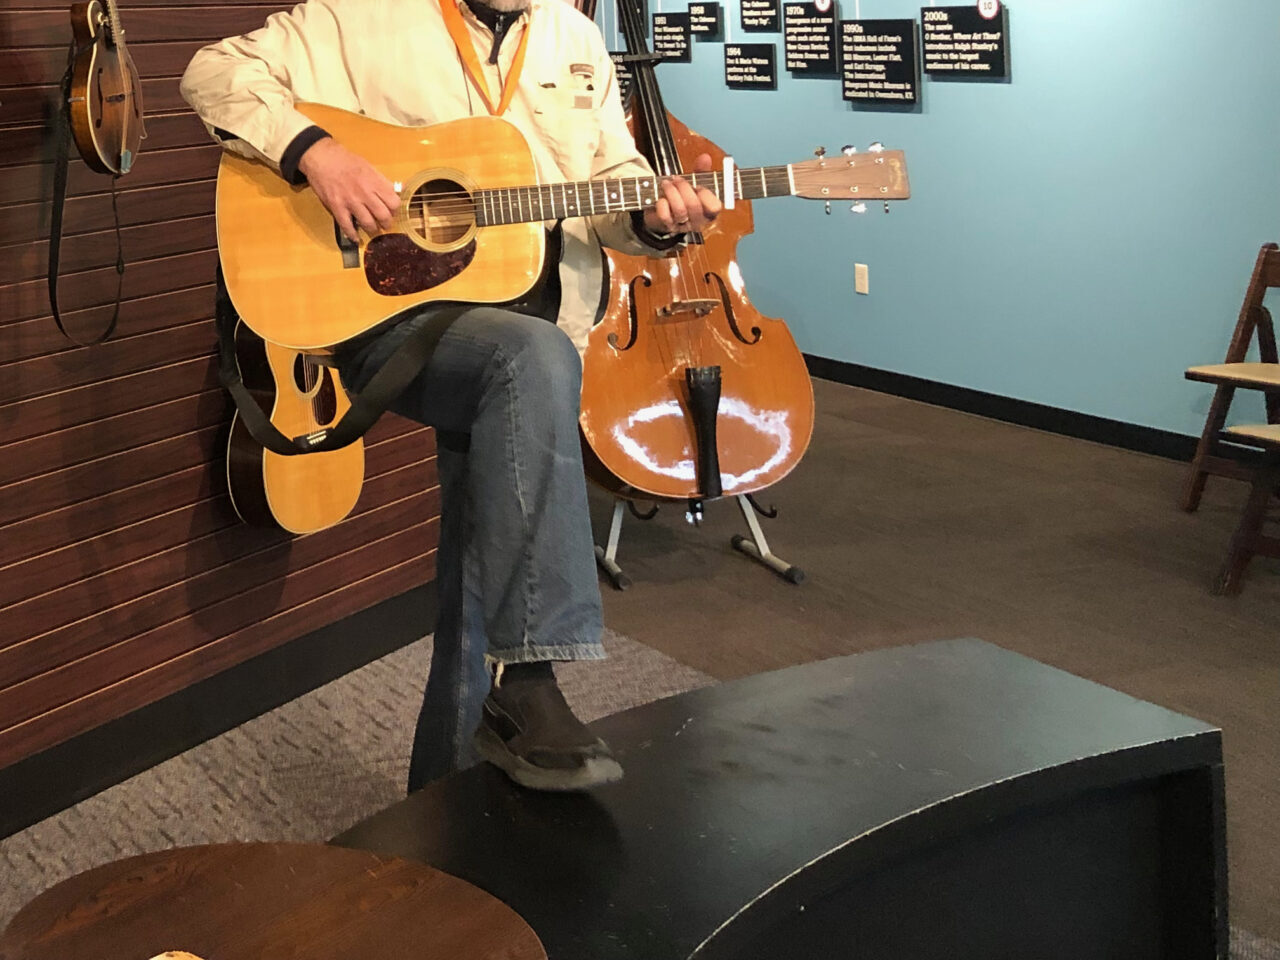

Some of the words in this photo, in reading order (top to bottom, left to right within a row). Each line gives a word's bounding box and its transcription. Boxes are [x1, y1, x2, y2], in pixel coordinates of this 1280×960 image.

[983, 2, 992, 10] 10
[924, 11, 948, 21] 2000s
[843, 24, 863, 33] 1990s
